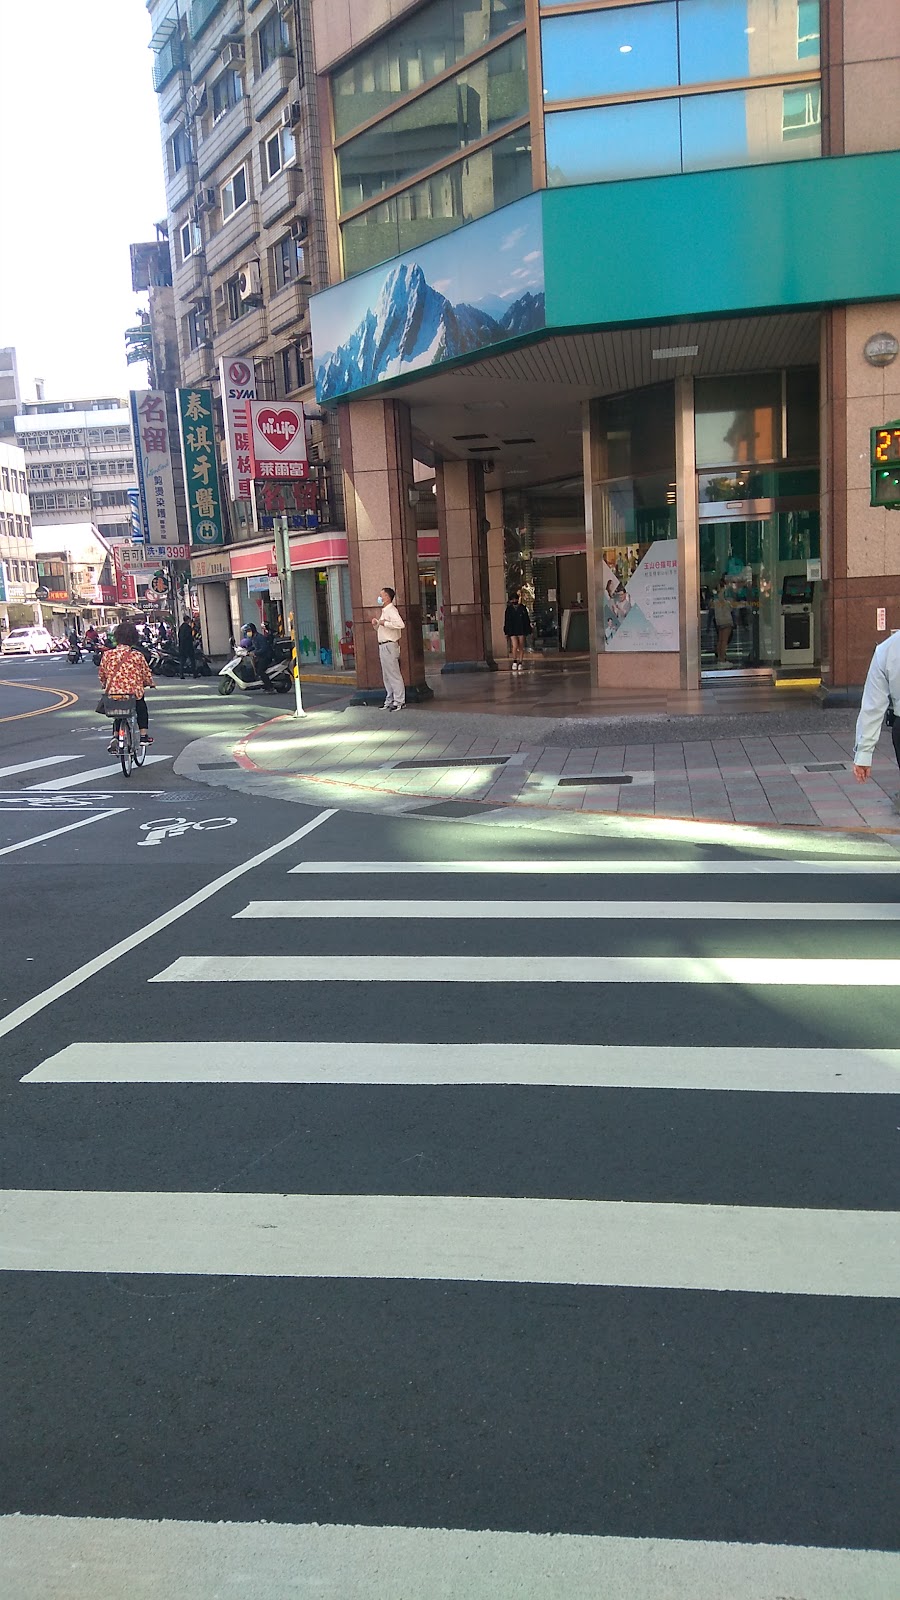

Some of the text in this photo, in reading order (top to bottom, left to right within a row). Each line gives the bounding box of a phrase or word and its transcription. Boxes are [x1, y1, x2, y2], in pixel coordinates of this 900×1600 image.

[228, 389, 256, 399] SYM
[139, 394, 167, 454] 名留
[184, 392, 216, 519] 泰祺牙醫
[260, 462, 304, 477] 萊爾富
[166, 546, 185, 559] 399
